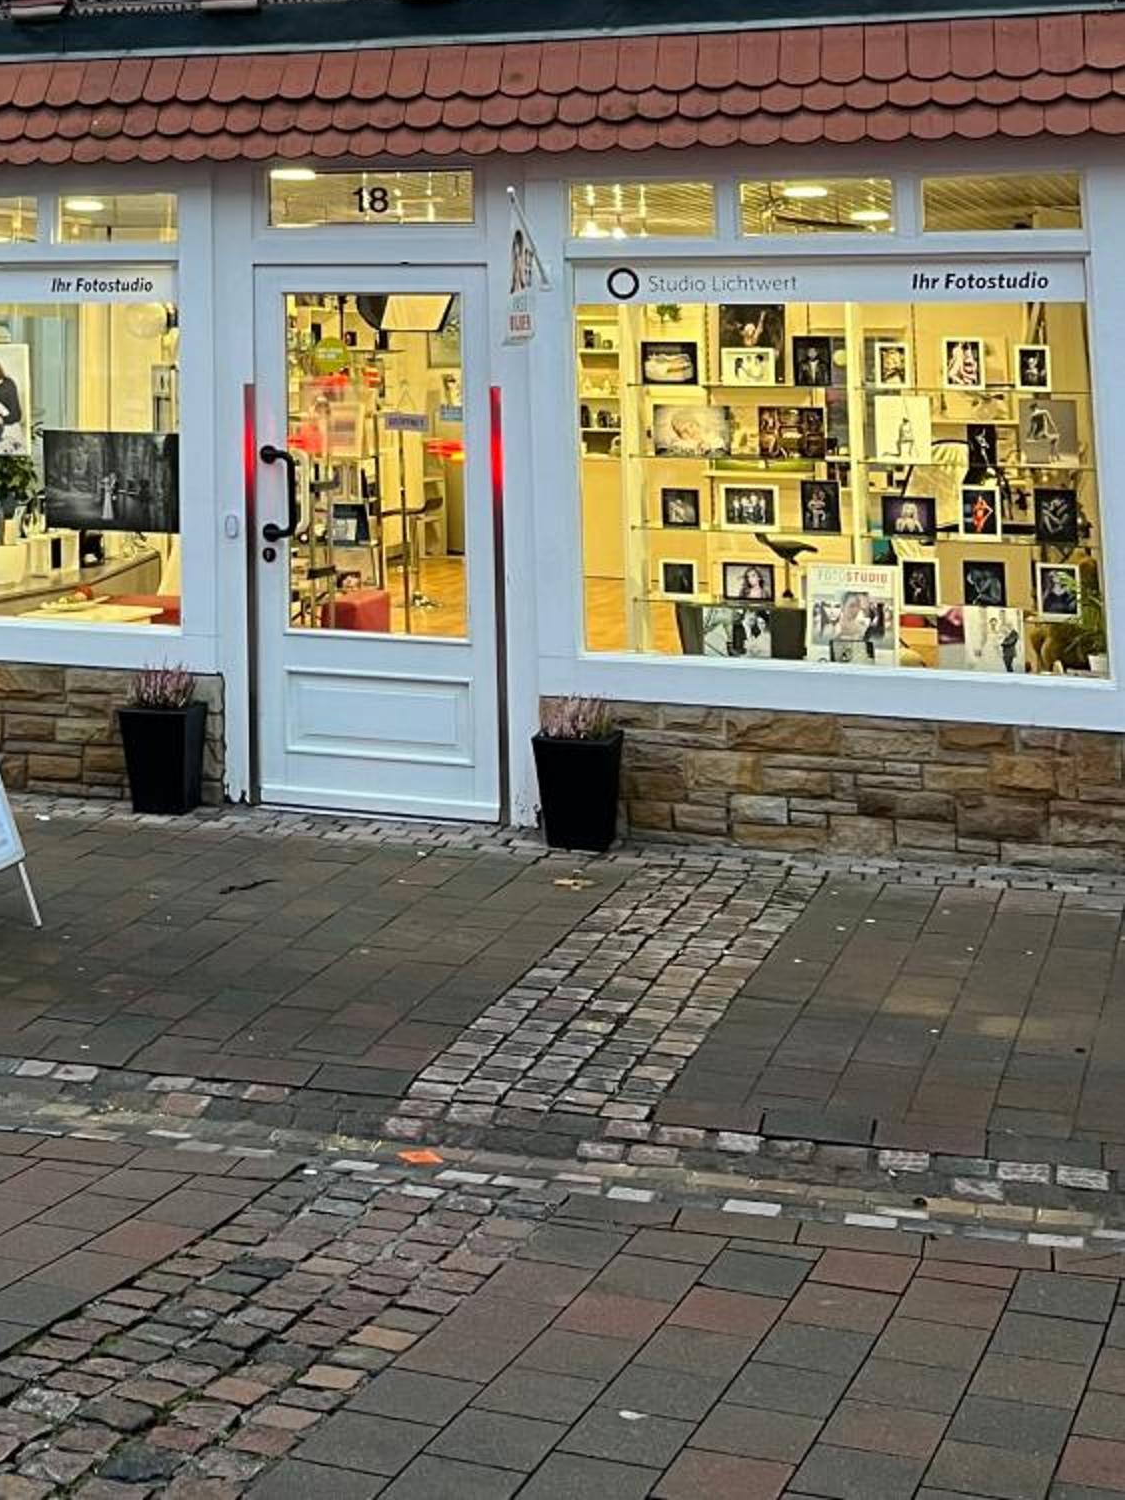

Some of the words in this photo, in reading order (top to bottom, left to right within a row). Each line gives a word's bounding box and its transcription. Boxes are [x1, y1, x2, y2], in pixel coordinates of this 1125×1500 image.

[353, 187, 389, 213] 18
[51, 277, 71, 293] Ihr
[76, 277, 154, 293] Fotostudio
[648, 275, 706, 292] Studio
[712, 275, 796, 291] Lichtwert
[912, 273, 940, 290] Ihr
[944, 271, 1049, 290] Fotostudio
[818, 568, 889, 584] FOTOSTUDIO
